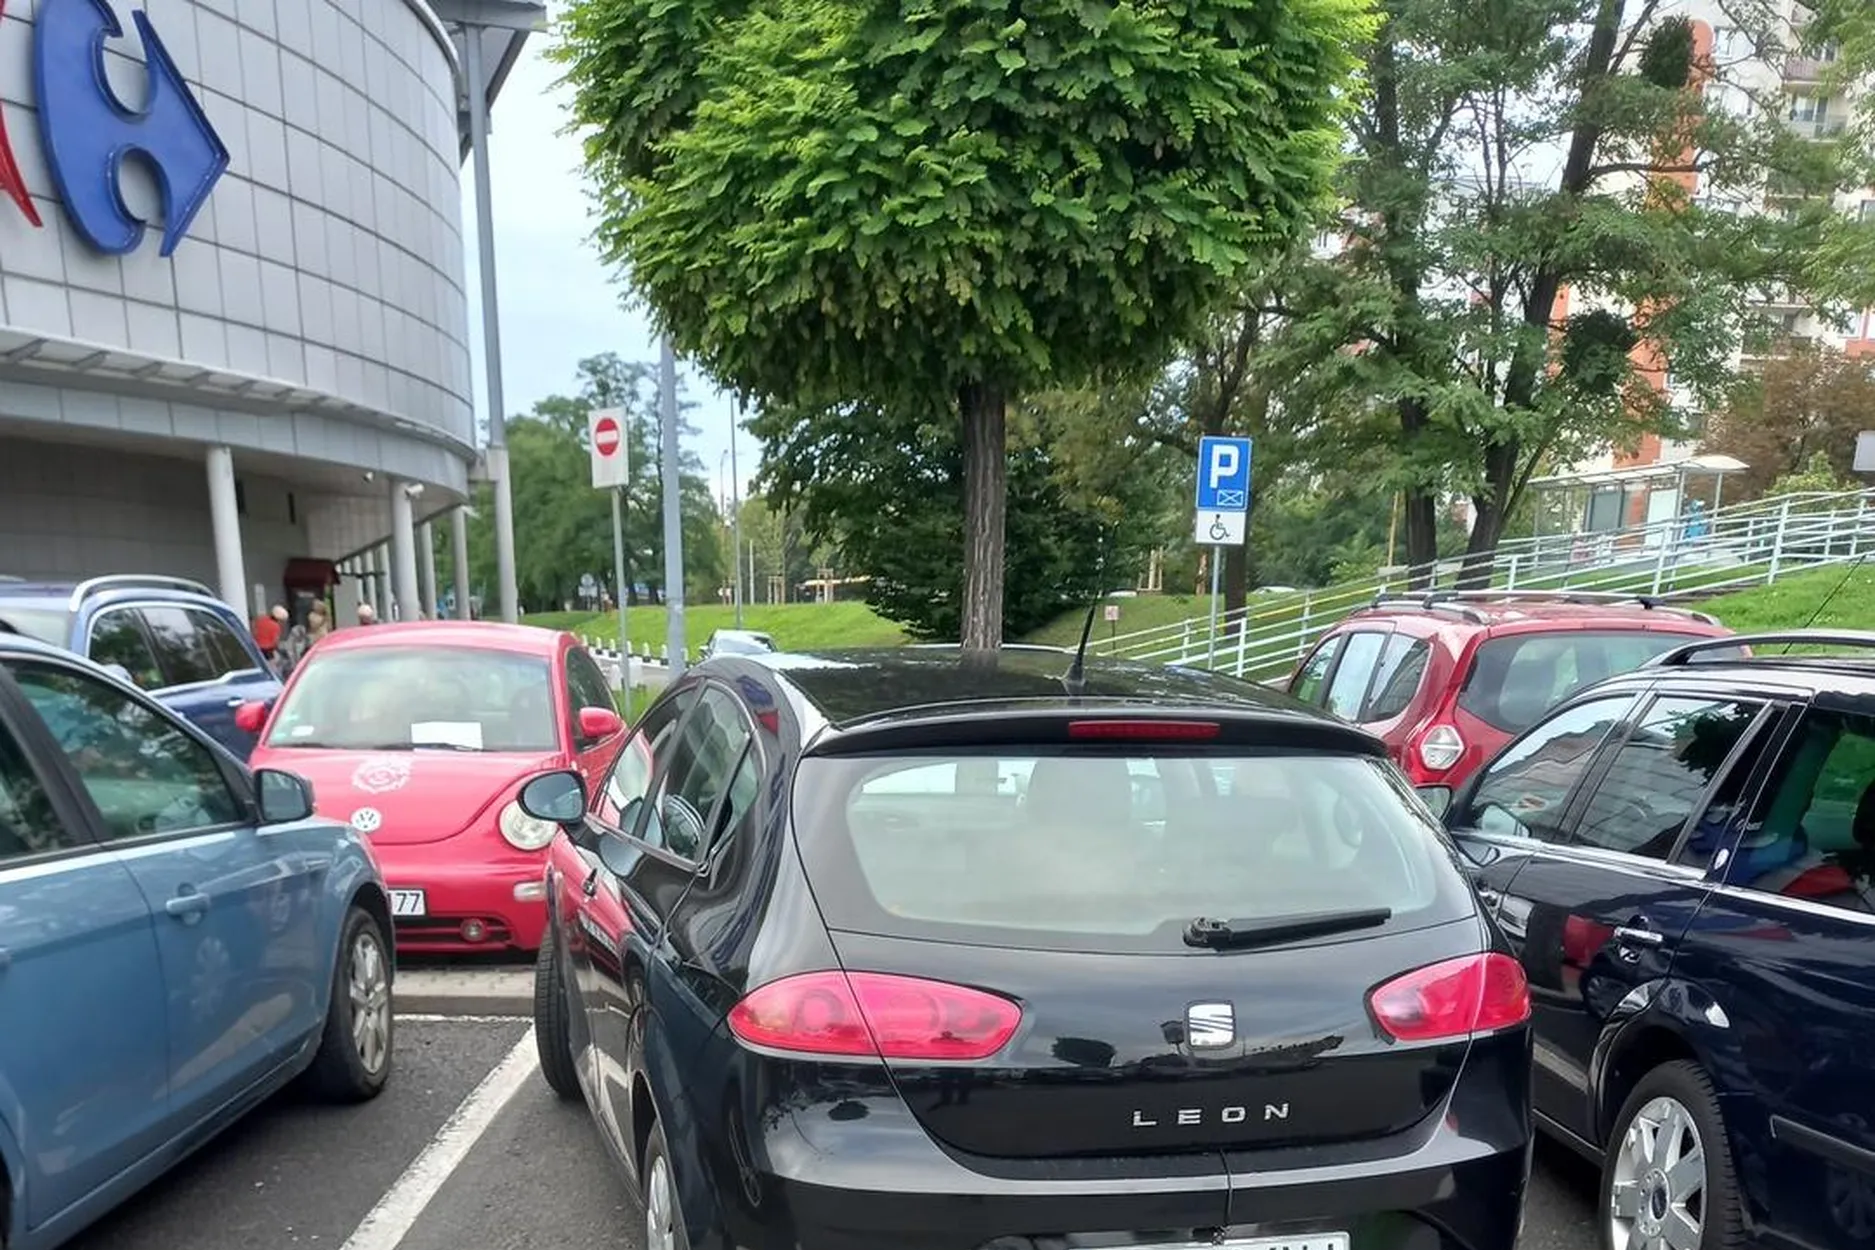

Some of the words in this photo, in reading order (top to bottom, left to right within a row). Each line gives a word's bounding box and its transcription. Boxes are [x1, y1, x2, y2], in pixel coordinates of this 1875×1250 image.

[1210, 444, 1239, 489] P
[395, 892, 421, 913] 77
[1133, 1103, 1289, 1126] LEON
